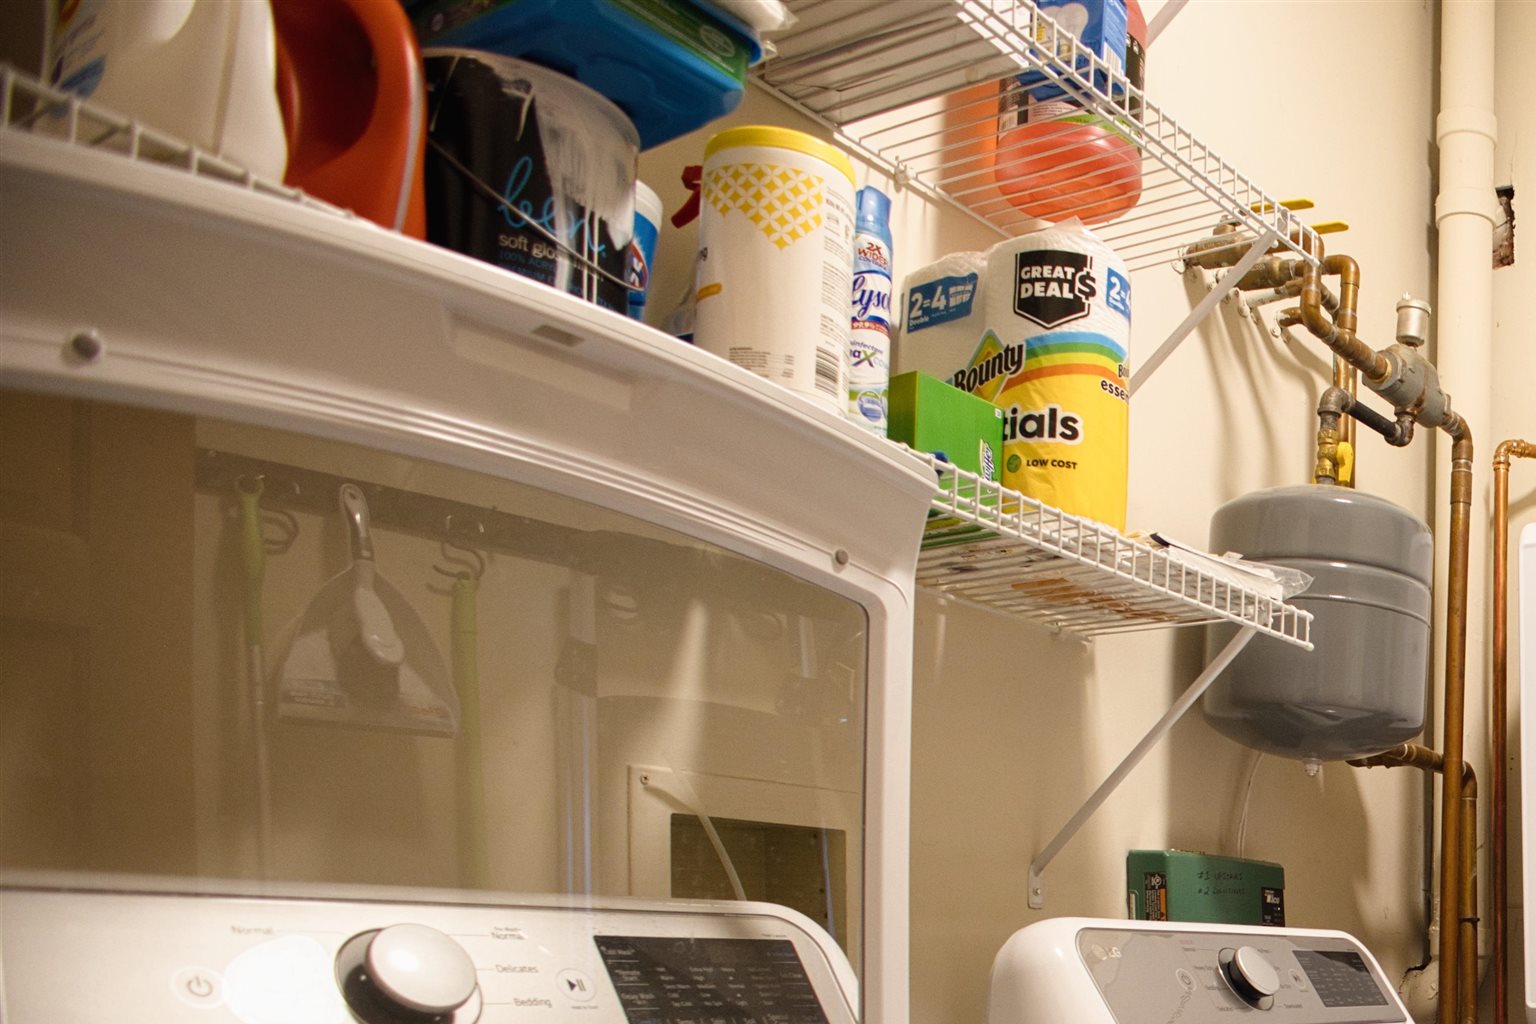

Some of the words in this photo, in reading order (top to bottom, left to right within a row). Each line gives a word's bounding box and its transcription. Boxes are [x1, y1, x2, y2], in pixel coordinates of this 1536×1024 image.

[499, 234, 528, 251] soft
[867, 242, 882, 256] 2X
[858, 247, 888, 266] WIDER
[1020, 265, 1076, 280] GREAT
[1020, 281, 1074, 300] DEAL
[910, 285, 947, 319] 2=4
[953, 343, 1025, 394] Bounty
[1026, 459, 1049, 468] LOW
[1050, 459, 1078, 470] COST
[495, 963, 539, 974] Delicates
[513, 997, 552, 1009] Bedding
